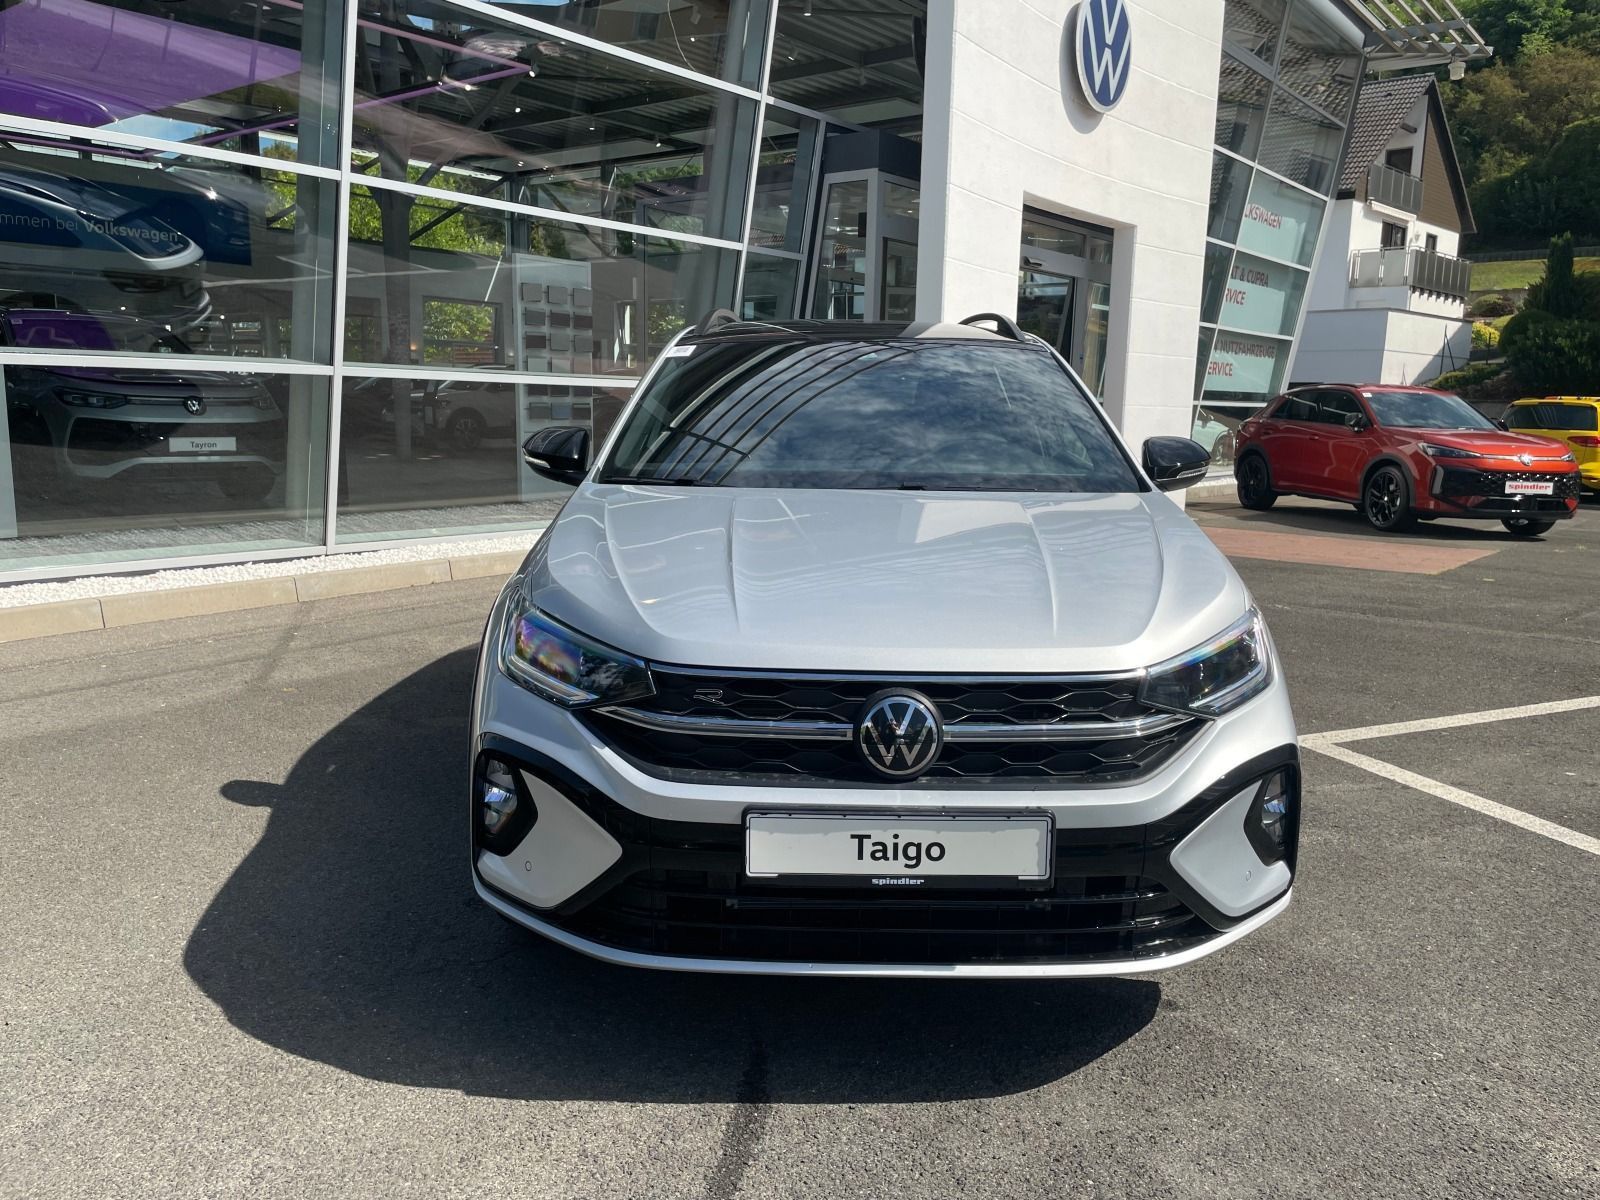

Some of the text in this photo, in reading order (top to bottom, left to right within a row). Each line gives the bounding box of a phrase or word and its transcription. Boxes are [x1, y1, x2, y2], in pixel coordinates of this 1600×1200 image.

[55, 215, 78, 231] bei
[84, 219, 179, 243] Volkswagen
[1247, 269, 1269, 289] CUPRA
[1219, 340, 1276, 359] NUTZFAHRZEUGE
[190, 441, 217, 450] Tayron
[850, 833, 946, 869] Taigo
[871, 877, 925, 886] spindler
